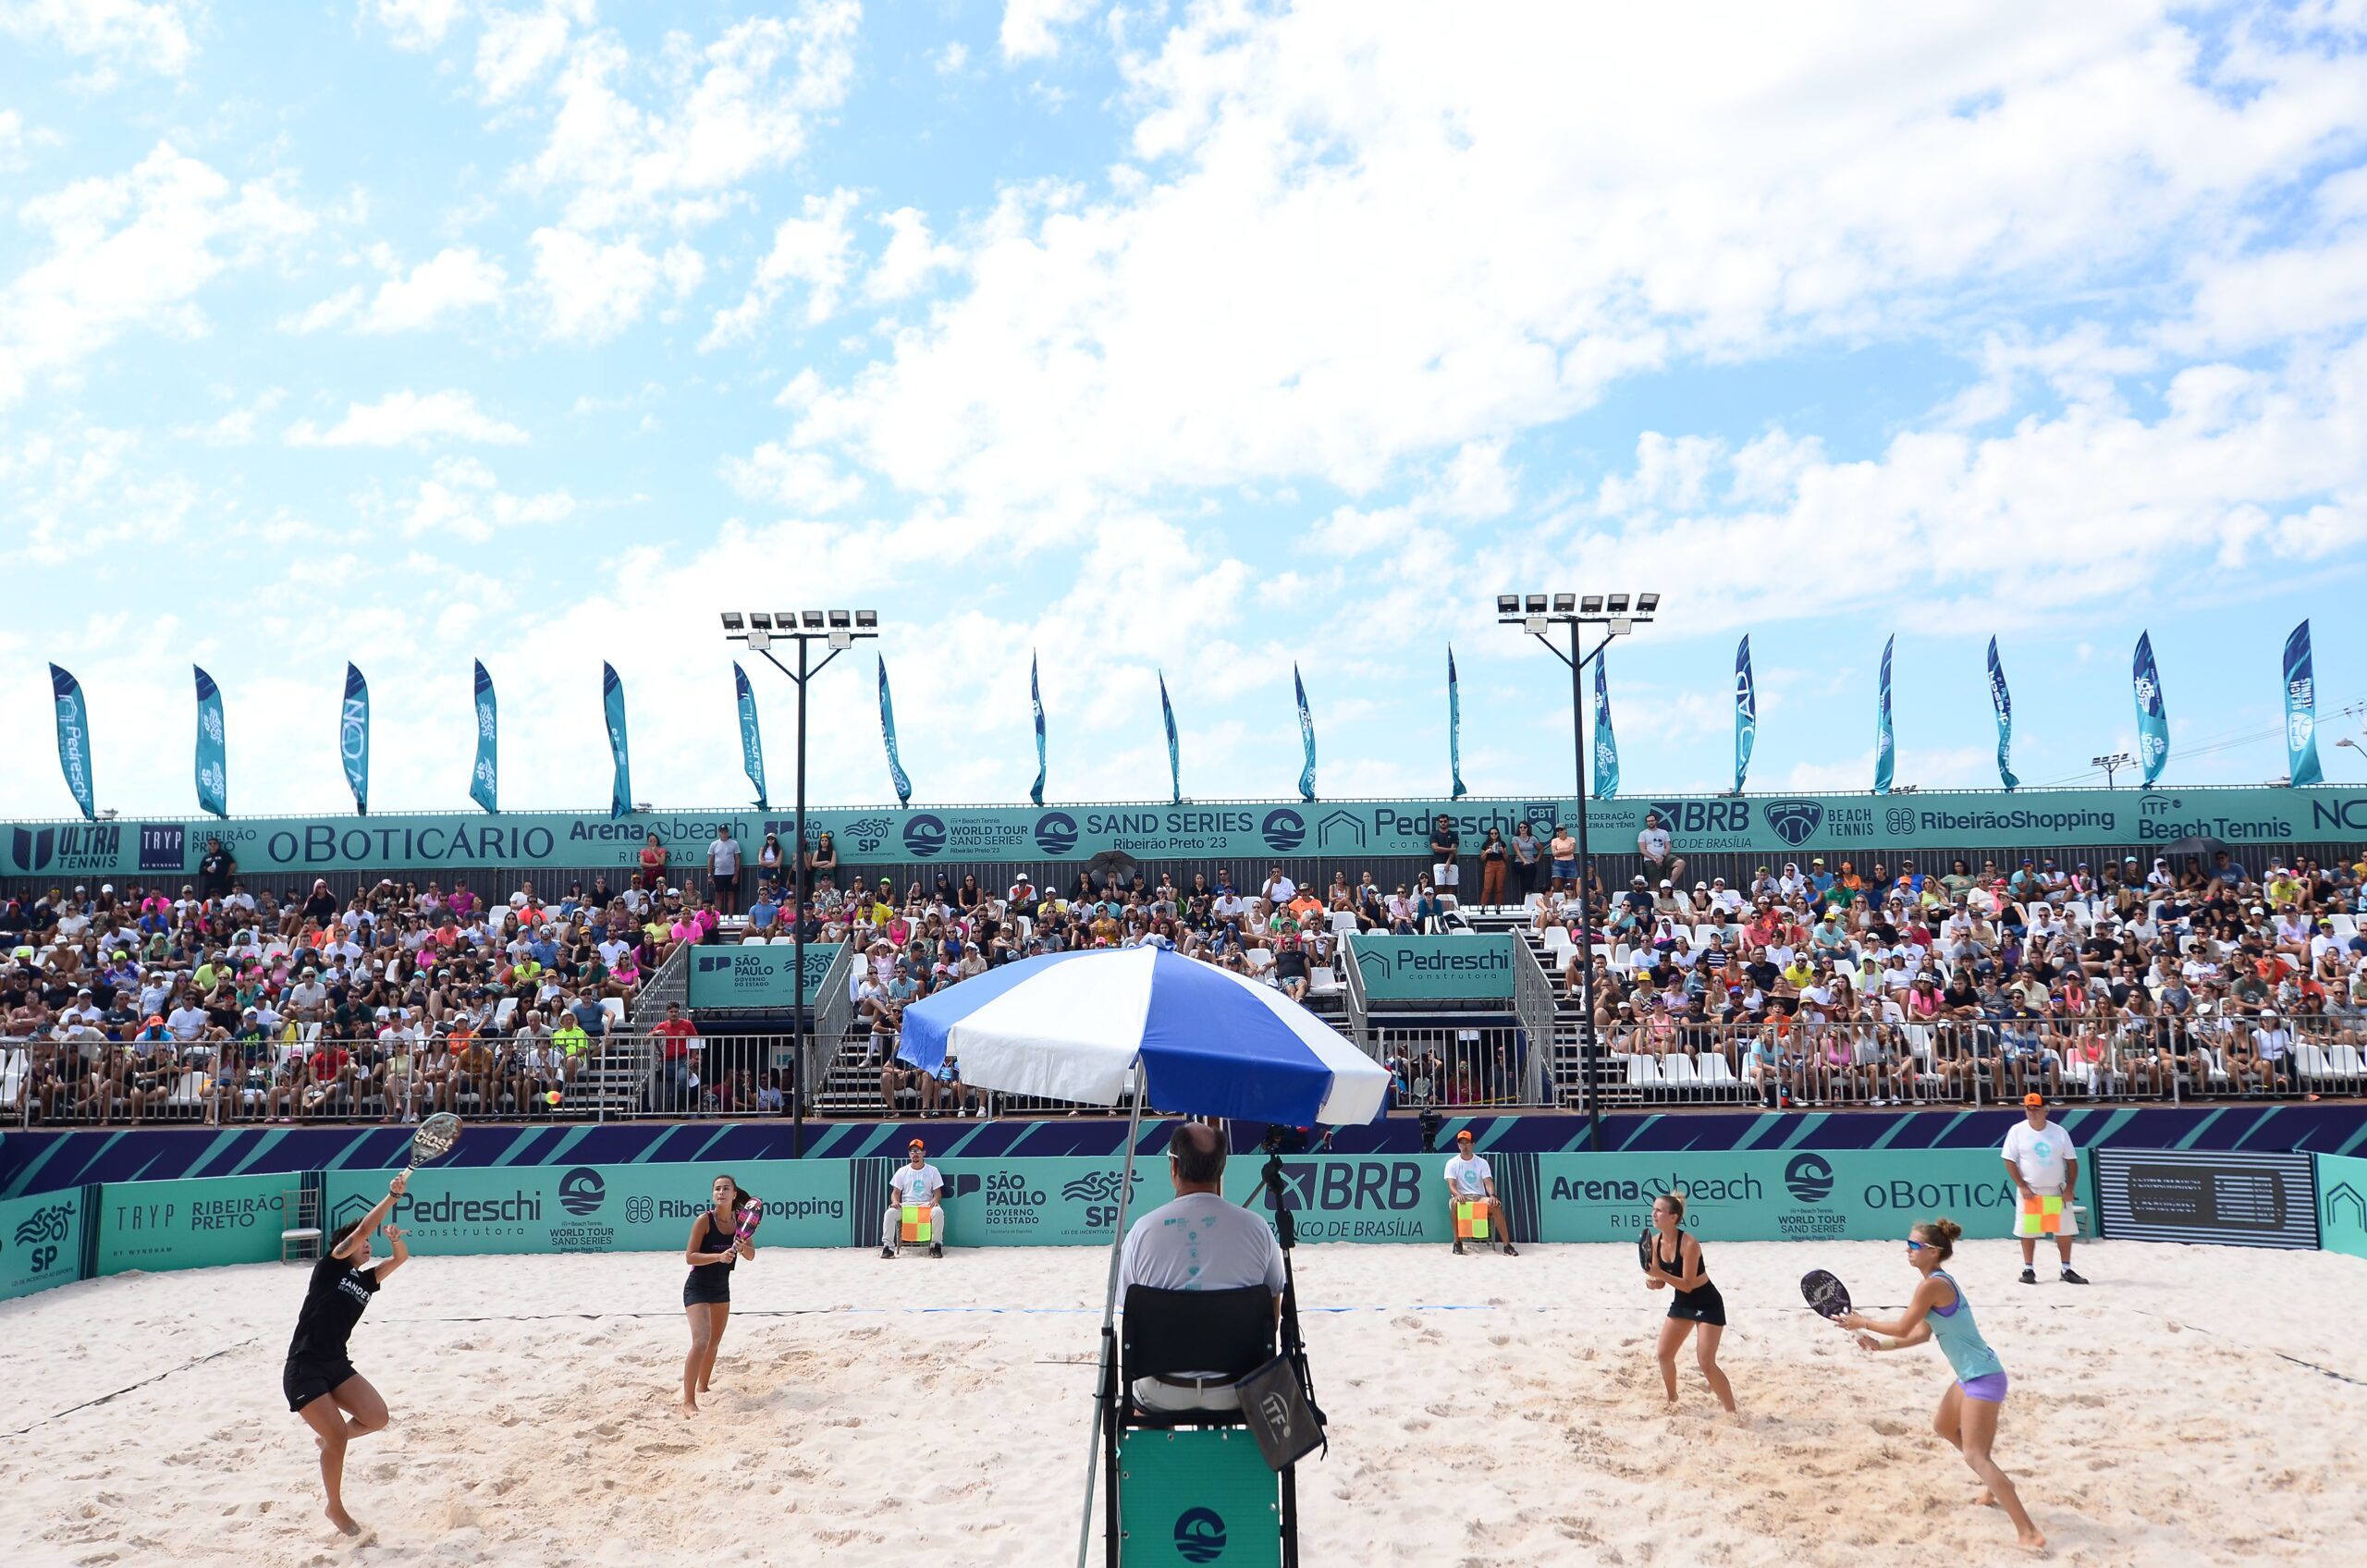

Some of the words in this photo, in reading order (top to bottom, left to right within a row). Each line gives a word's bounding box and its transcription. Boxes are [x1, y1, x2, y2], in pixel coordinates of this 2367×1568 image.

[1528, 808, 1554, 819] CBT
[1770, 803, 1818, 816] FPT
[1828, 809, 1871, 822] BEACH
[2141, 802, 2168, 815] ITF
[804, 818, 823, 830] ÃO
[1086, 814, 1159, 835] SAND
[1166, 812, 1254, 833] SERIES
[1616, 820, 1636, 828] TÊNIS
[1684, 801, 1750, 832] BRB
[1920, 809, 2116, 831] RibeirãoShopping
[192, 827, 257, 842] RIBEIRÃO
[570, 820, 644, 841] Arena
[950, 826, 993, 836] WORLD
[995, 825, 1028, 835] TOUR
[1828, 823, 1874, 837] TENNIS
[2139, 817, 2211, 839] Beach
[2214, 816, 2292, 838] Tennis
[58, 826, 120, 855] ULTRA
[143, 831, 181, 850] TRYP
[858, 839, 880, 852] SP
[950, 836, 982, 846] SAND
[984, 834, 1024, 845] SERIES
[1112, 837, 1167, 850] Ribeirão
[1169, 837, 1205, 850] Preto
[1688, 839, 1704, 849] DE
[1706, 836, 1751, 849] BRASÍLIA
[58, 855, 118, 869] TENNIS
[735, 954, 760, 966] SÃO
[1398, 949, 1508, 971] Pedreschi
[734, 966, 774, 976] PAULO
[987, 1170, 1025, 1190] SÃO
[1319, 1162, 1421, 1209] BRB
[1551, 1176, 1638, 1200] Arena
[1673, 1172, 1762, 1200] beach
[191, 1194, 284, 1216] RIBEIRÃO
[986, 1190, 1046, 1207] PAULO
[392, 1191, 541, 1222] Pedreschi
[117, 1204, 175, 1231] TRYP
[191, 1213, 255, 1231] PRETO
[1085, 1207, 1119, 1227] SP
[1778, 1216, 1815, 1224] WORLD
[407, 1226, 524, 1237] construtora
[550, 1229, 584, 1237] WORLD
[587, 1228, 614, 1236] TOUR
[1328, 1221, 1350, 1236] DE
[1354, 1218, 1424, 1236] BRASÍLIA
[1781, 1225, 1809, 1233] SAND
[31, 1245, 57, 1272] SP
[129, 1247, 172, 1256] WYNDHAM
[1262, 1395, 1286, 1425] ITF
